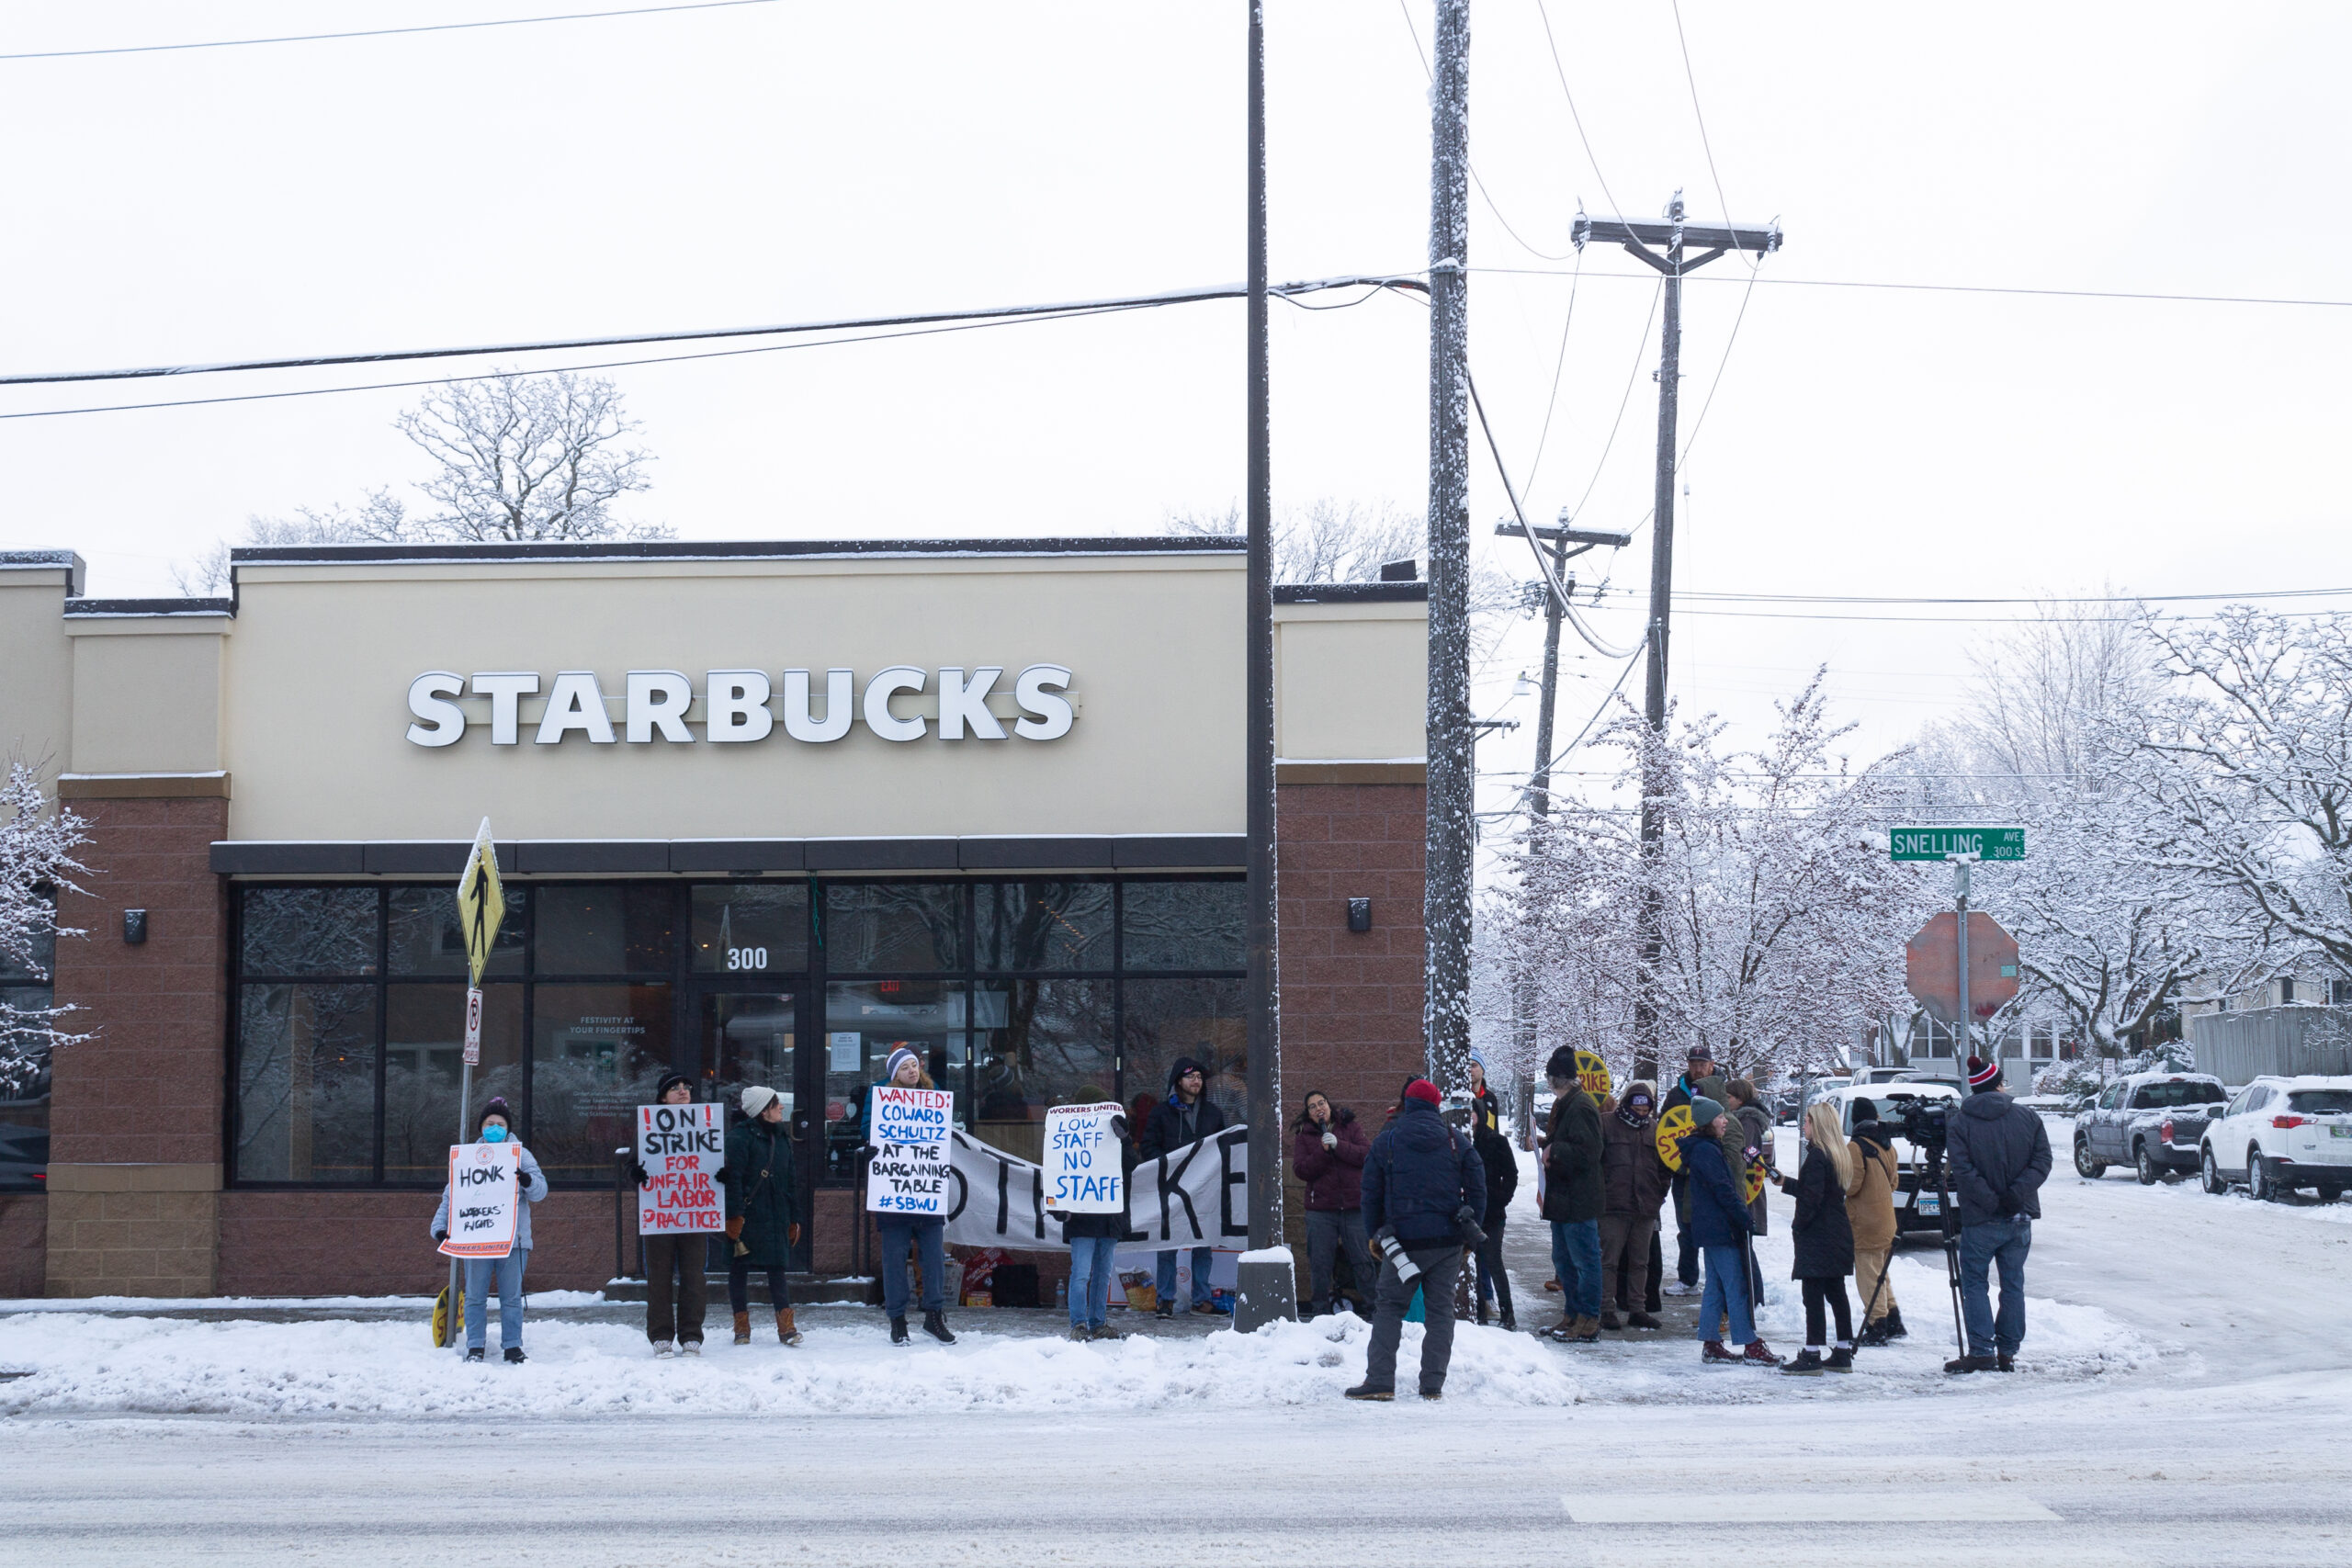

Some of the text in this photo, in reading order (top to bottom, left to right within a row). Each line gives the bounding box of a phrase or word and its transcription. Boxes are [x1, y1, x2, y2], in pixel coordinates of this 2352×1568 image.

[405, 663, 1075, 748] STARBUCKS
[1894, 831, 2020, 855] SNELLING AVE
[1994, 846, 2021, 857] 300 S
[727, 947, 768, 970] 300
[581, 1016, 635, 1024] FESTIVITY AT
[1577, 1073, 1608, 1093] RIKE
[878, 1088, 950, 1109] WANTED:
[882, 1104, 944, 1124] COWARD
[1093, 1104, 1123, 1112] UNITED
[878, 1123, 946, 1141] SCHULTZ
[1058, 1117, 1098, 1133] LOW
[645, 1129, 722, 1156] STRIKE
[1052, 1132, 1103, 1149] STAFF
[883, 1143, 940, 1159] AT THE
[1064, 1150, 1091, 1170] NO
[665, 1155, 699, 1171] FOR
[873, 1161, 950, 1179] BARGAINING
[460, 1165, 504, 1188] HONK
[641, 1173, 710, 1191] UNFAIR
[889, 1179, 943, 1195] TABLE
[1055, 1176, 1120, 1201] STAFF
[657, 1190, 716, 1208] LABOR
[878, 1196, 938, 1211] #SBWU
[464, 1219, 495, 1232] RIGHTS
